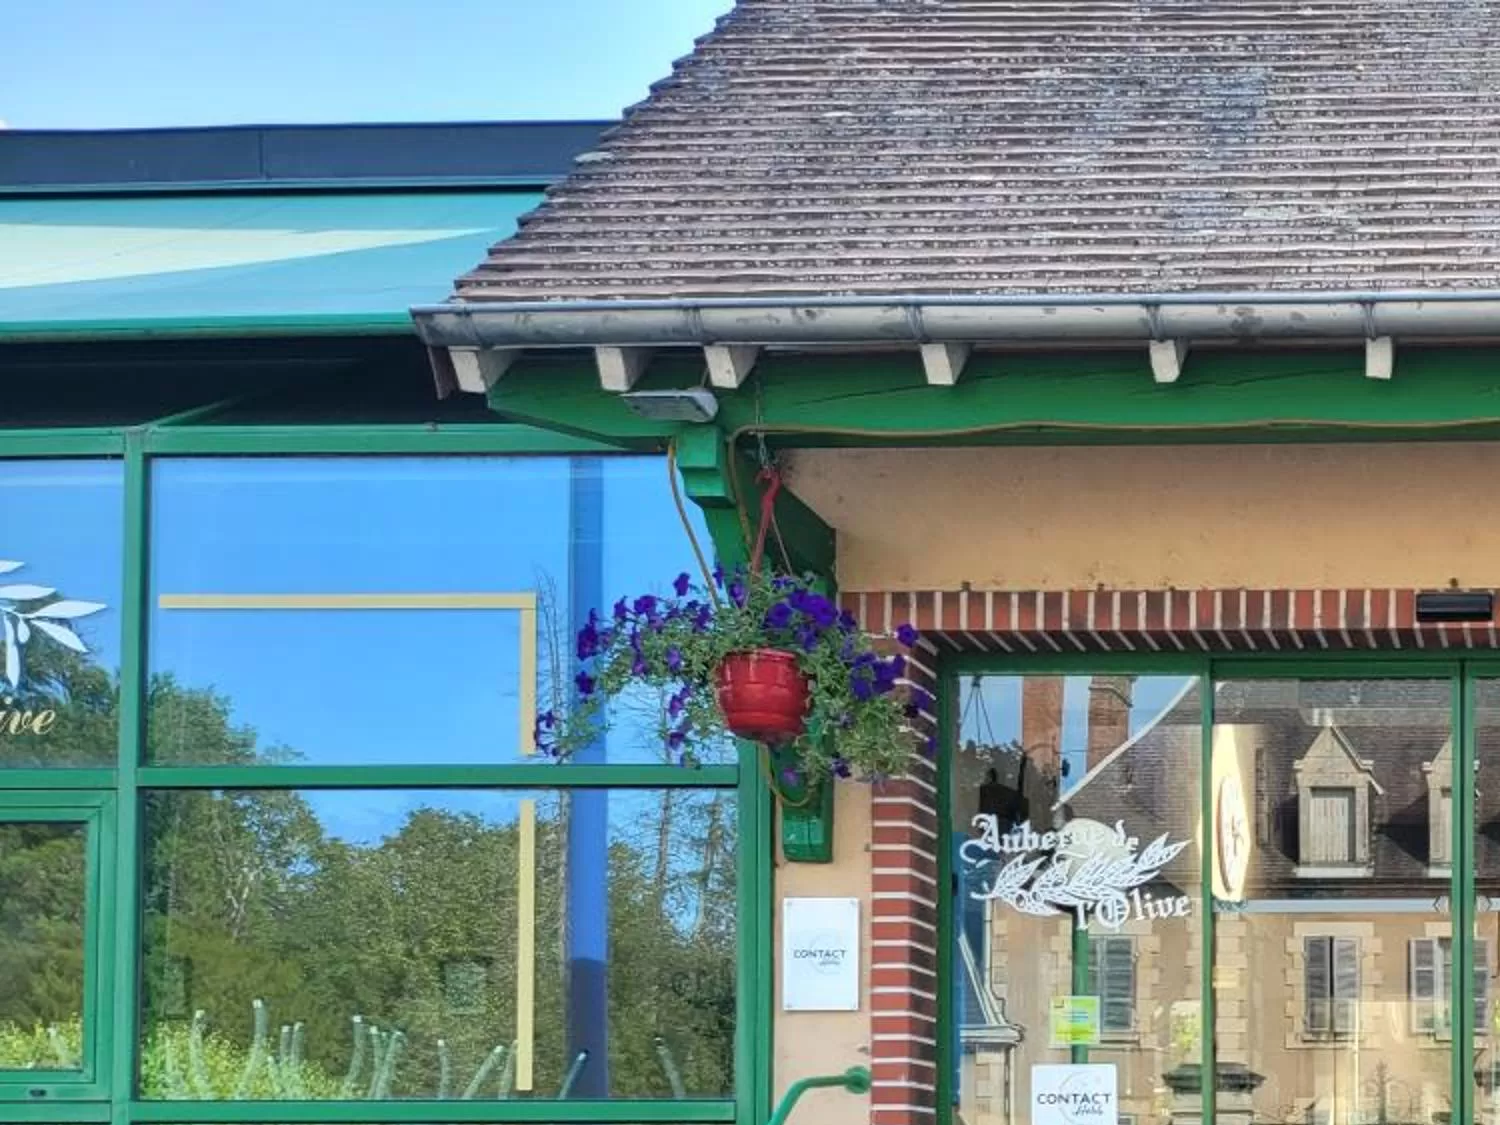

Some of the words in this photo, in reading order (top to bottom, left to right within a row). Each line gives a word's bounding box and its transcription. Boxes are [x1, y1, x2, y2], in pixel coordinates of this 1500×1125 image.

[1076, 888, 1192, 929] l'Olive
[793, 949, 847, 959] CONTACT
[1037, 1093, 1112, 1105] CONTACT
